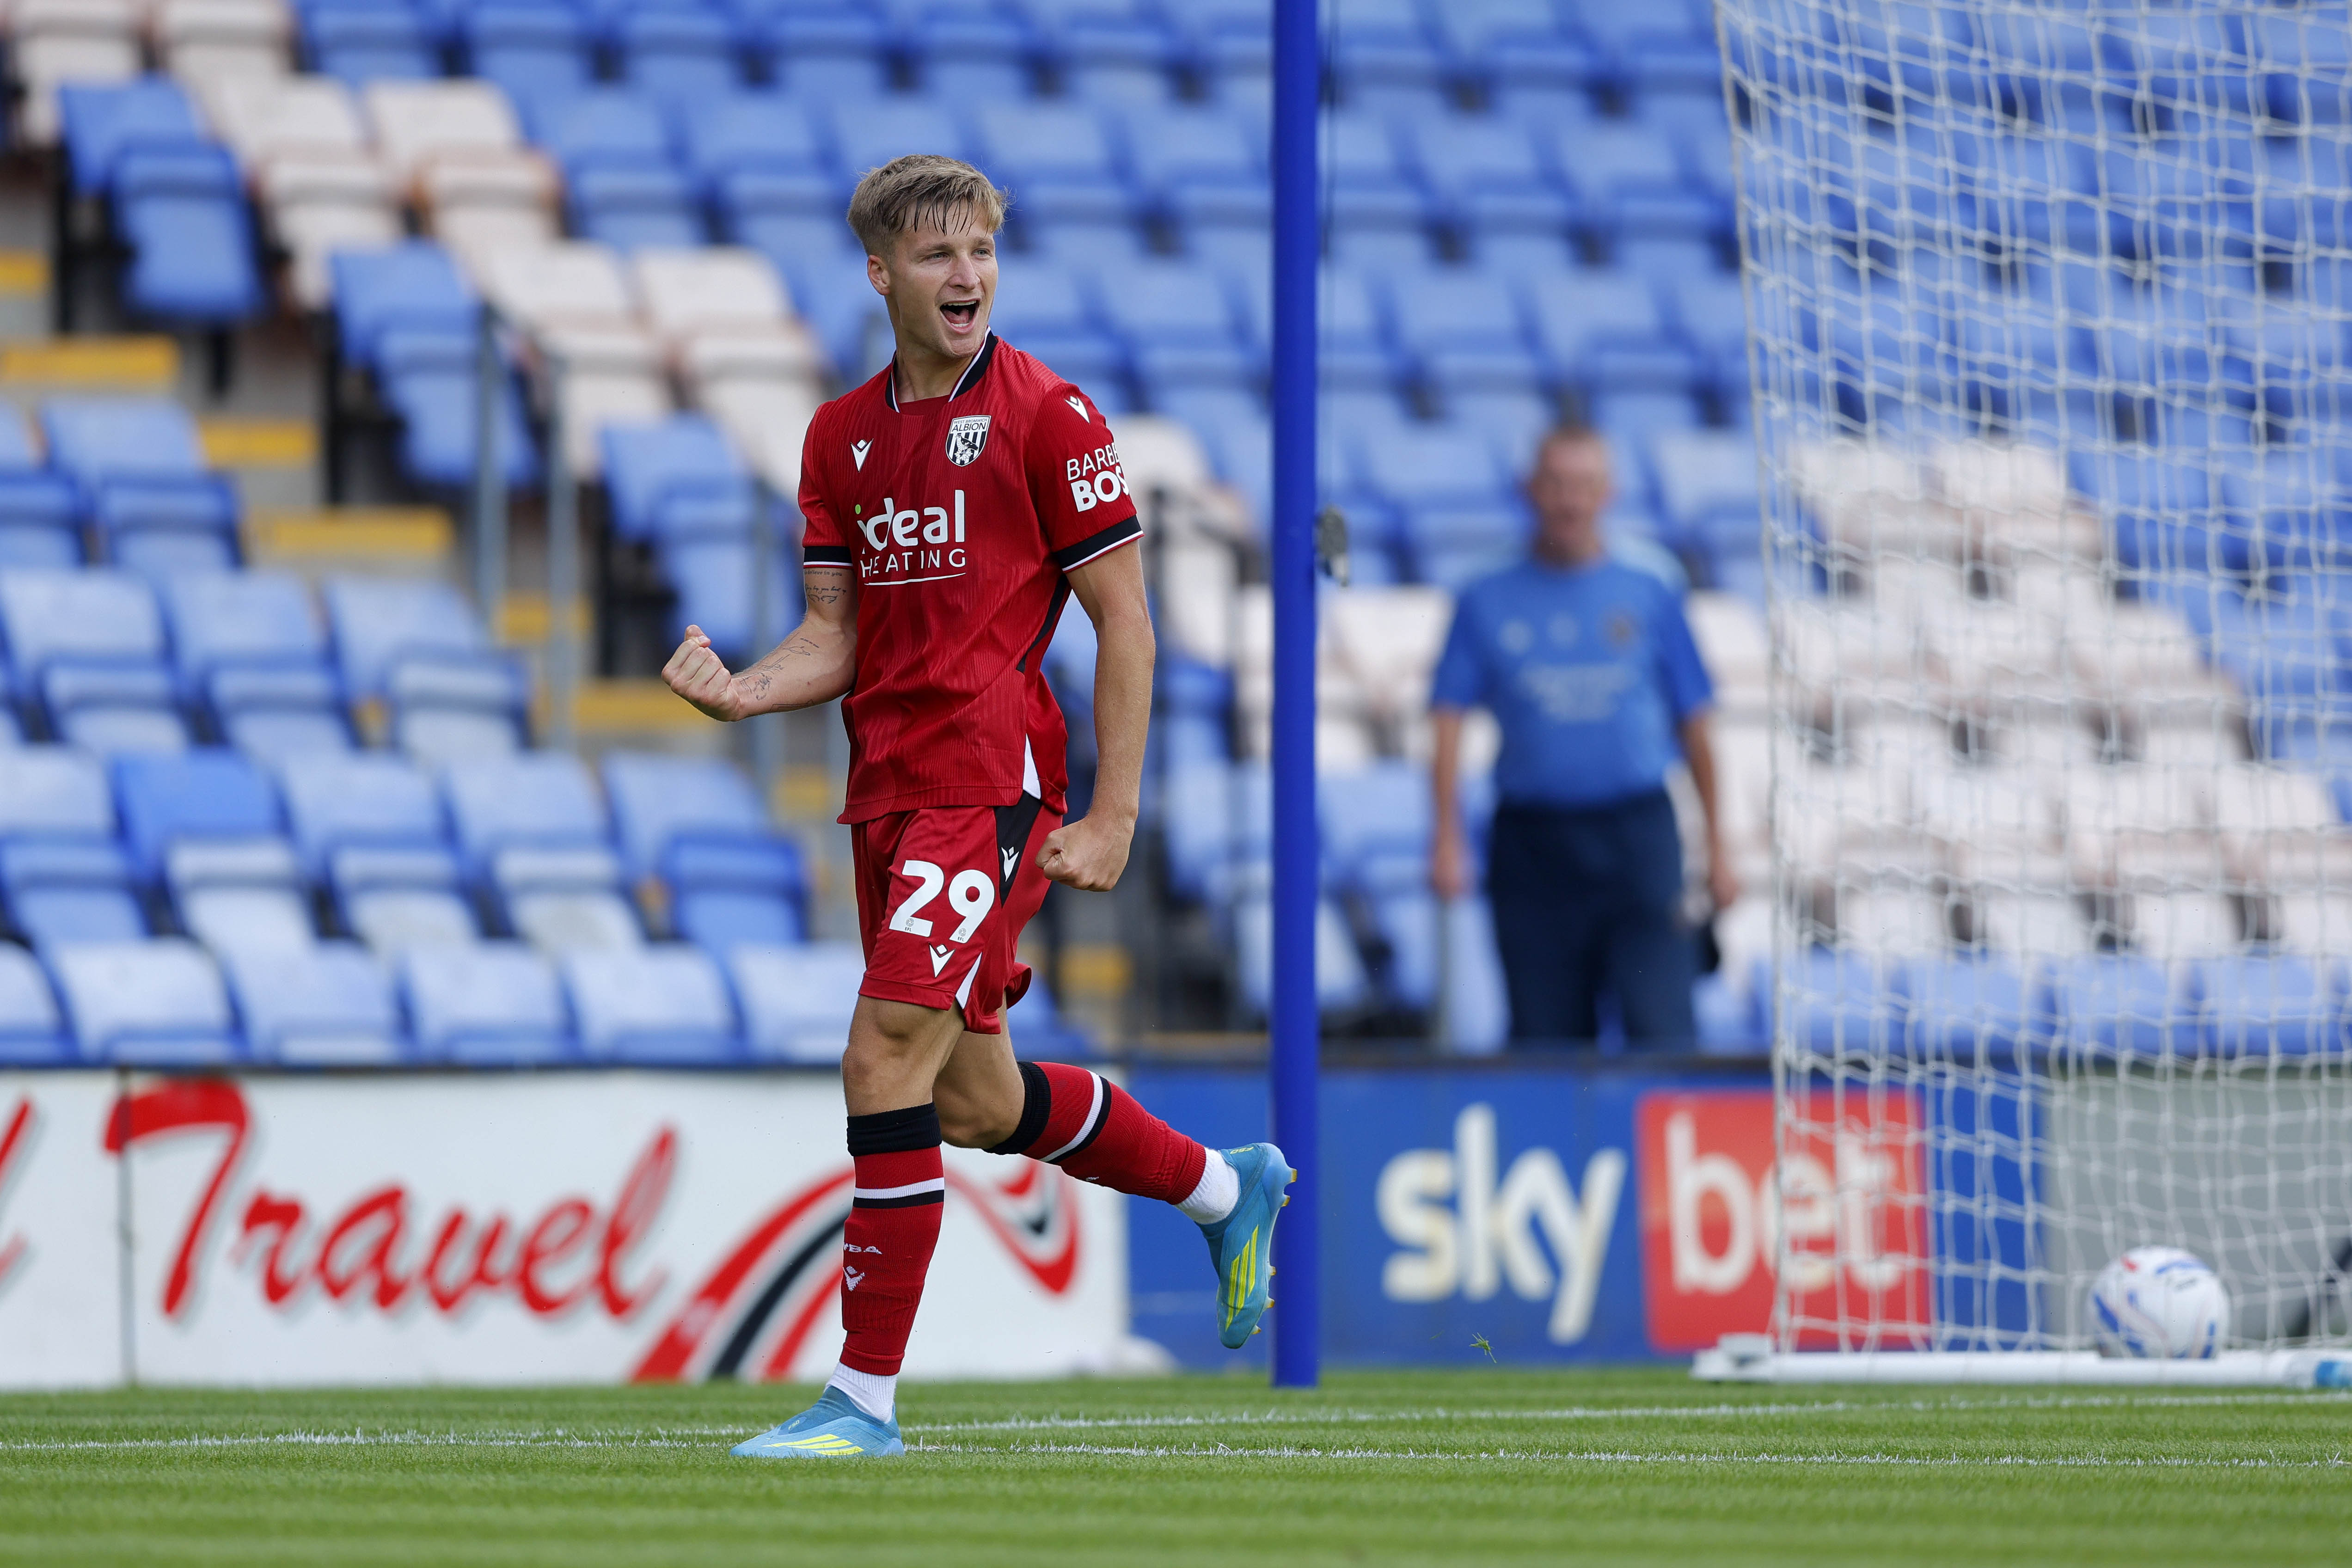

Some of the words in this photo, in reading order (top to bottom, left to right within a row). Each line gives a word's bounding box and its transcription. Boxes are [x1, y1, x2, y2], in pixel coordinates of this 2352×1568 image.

[952, 423, 986, 432] ALBION
[855, 490, 965, 554] ideal
[860, 549, 966, 577] HEATING
[888, 860, 995, 943] 29
[104, 1073, 675, 1317] Travel
[1376, 1101, 1628, 1344] sky
[1666, 1110, 1900, 1292] bet
